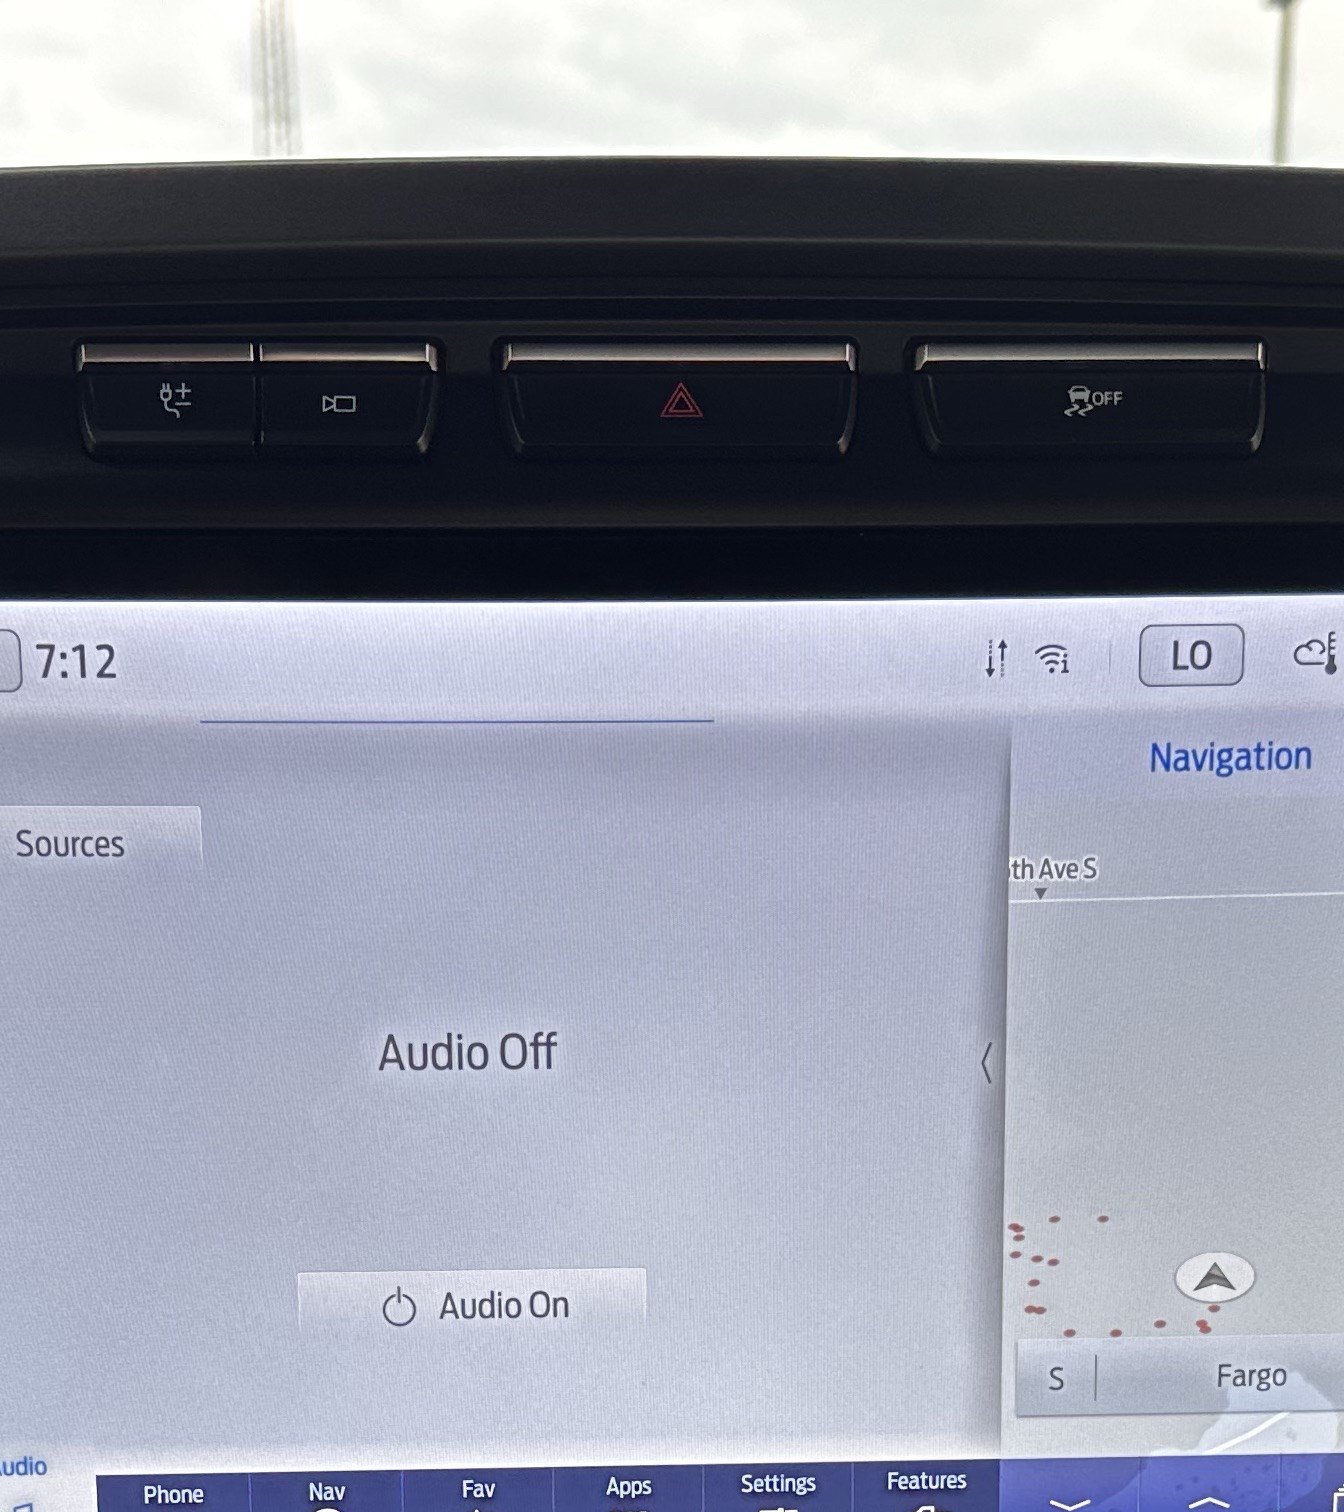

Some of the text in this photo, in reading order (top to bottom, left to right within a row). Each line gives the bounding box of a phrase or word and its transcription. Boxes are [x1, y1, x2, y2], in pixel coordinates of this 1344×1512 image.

[1092, 391, 1123, 406] OFF
[36, 644, 117, 679] 7:12
[1172, 640, 1212, 671] LO
[1150, 743, 1312, 777] Navigation
[16, 829, 125, 858] Sources
[1008, 857, 1097, 880] th Ave S
[378, 1033, 558, 1071] Audio Off
[439, 1291, 570, 1322] Audio On
[1049, 1367, 1064, 1391] S
[1217, 1364, 1288, 1395] Fargo
[308, 1483, 346, 1502] Nav
[462, 1480, 496, 1498] Fav
[605, 1477, 652, 1500] Apps
[741, 1472, 817, 1497] Settings
[887, 1471, 967, 1490] Features
[143, 1485, 204, 1504] Phone
